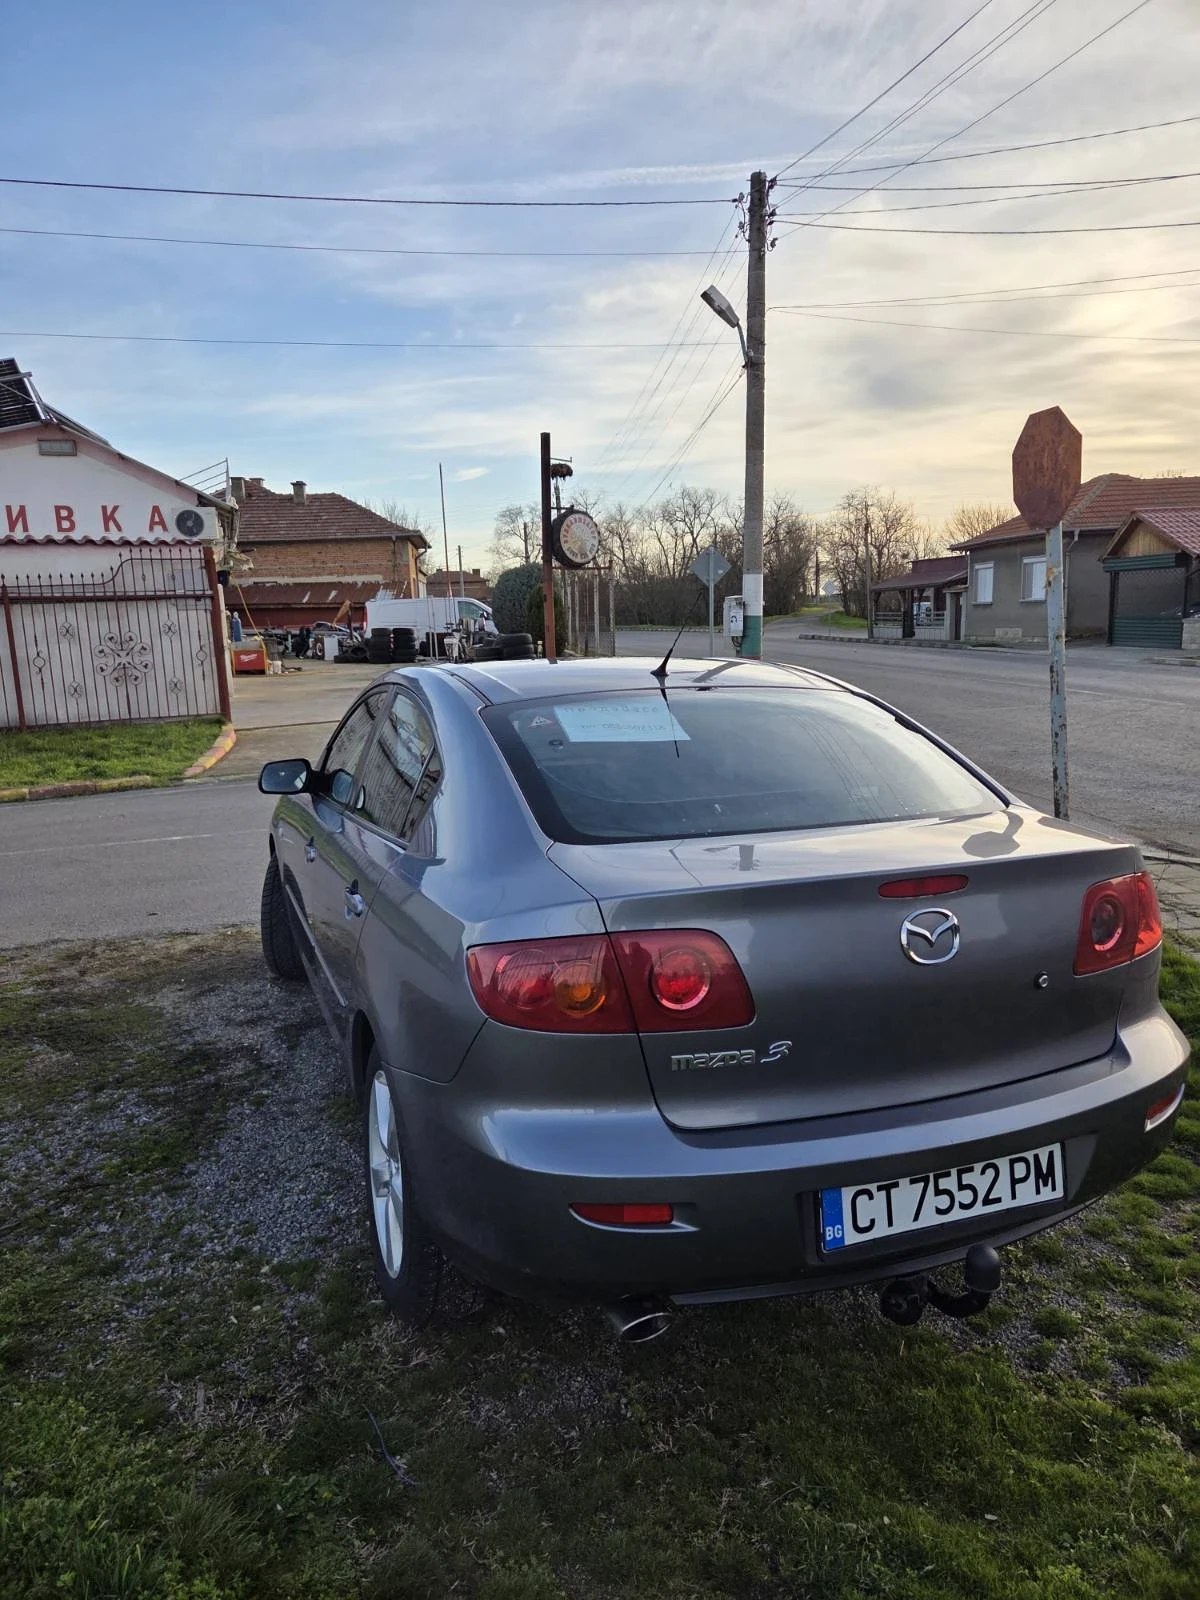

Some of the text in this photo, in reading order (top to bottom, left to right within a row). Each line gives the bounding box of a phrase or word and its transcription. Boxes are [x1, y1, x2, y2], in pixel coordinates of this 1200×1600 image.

[850, 1149, 1058, 1234] CT 7552 PM
[825, 1224, 843, 1241] BG
